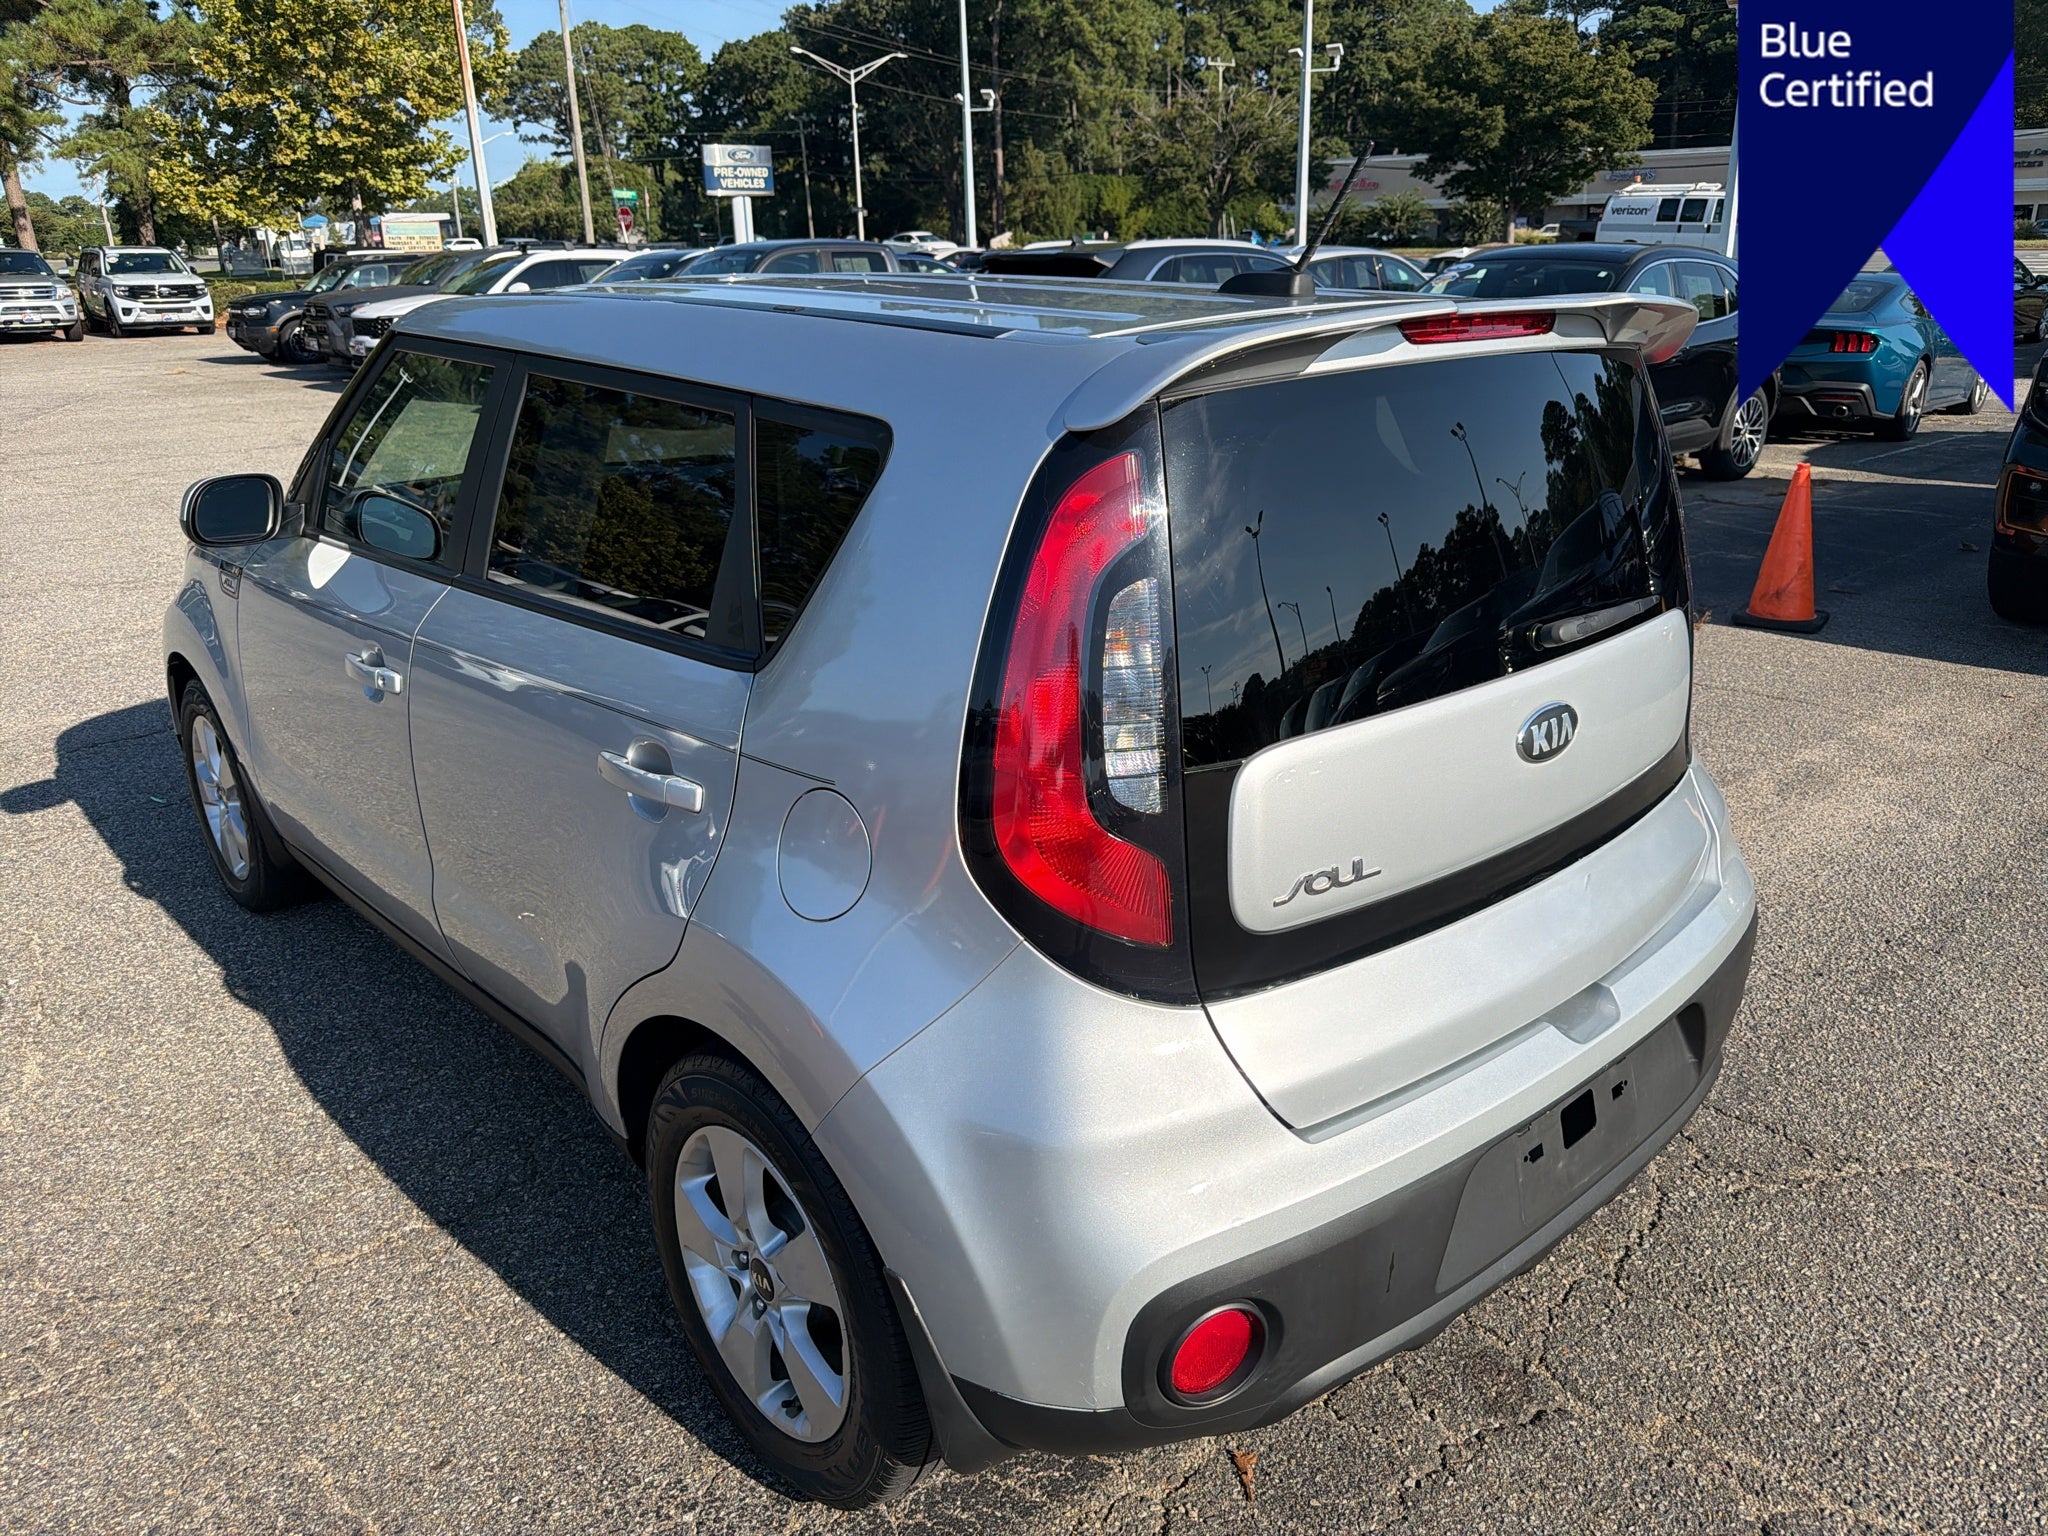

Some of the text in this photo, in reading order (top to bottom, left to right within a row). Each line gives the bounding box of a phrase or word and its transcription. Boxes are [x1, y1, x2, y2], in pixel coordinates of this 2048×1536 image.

[713, 166, 769, 178] PRE-OWNED
[720, 178, 766, 189] VEHICLES
[1611, 205, 1648, 216] verizon
[1530, 712, 1573, 756] KIA
[1272, 856, 1382, 908] SOUL
[752, 1271, 772, 1292] KIA
